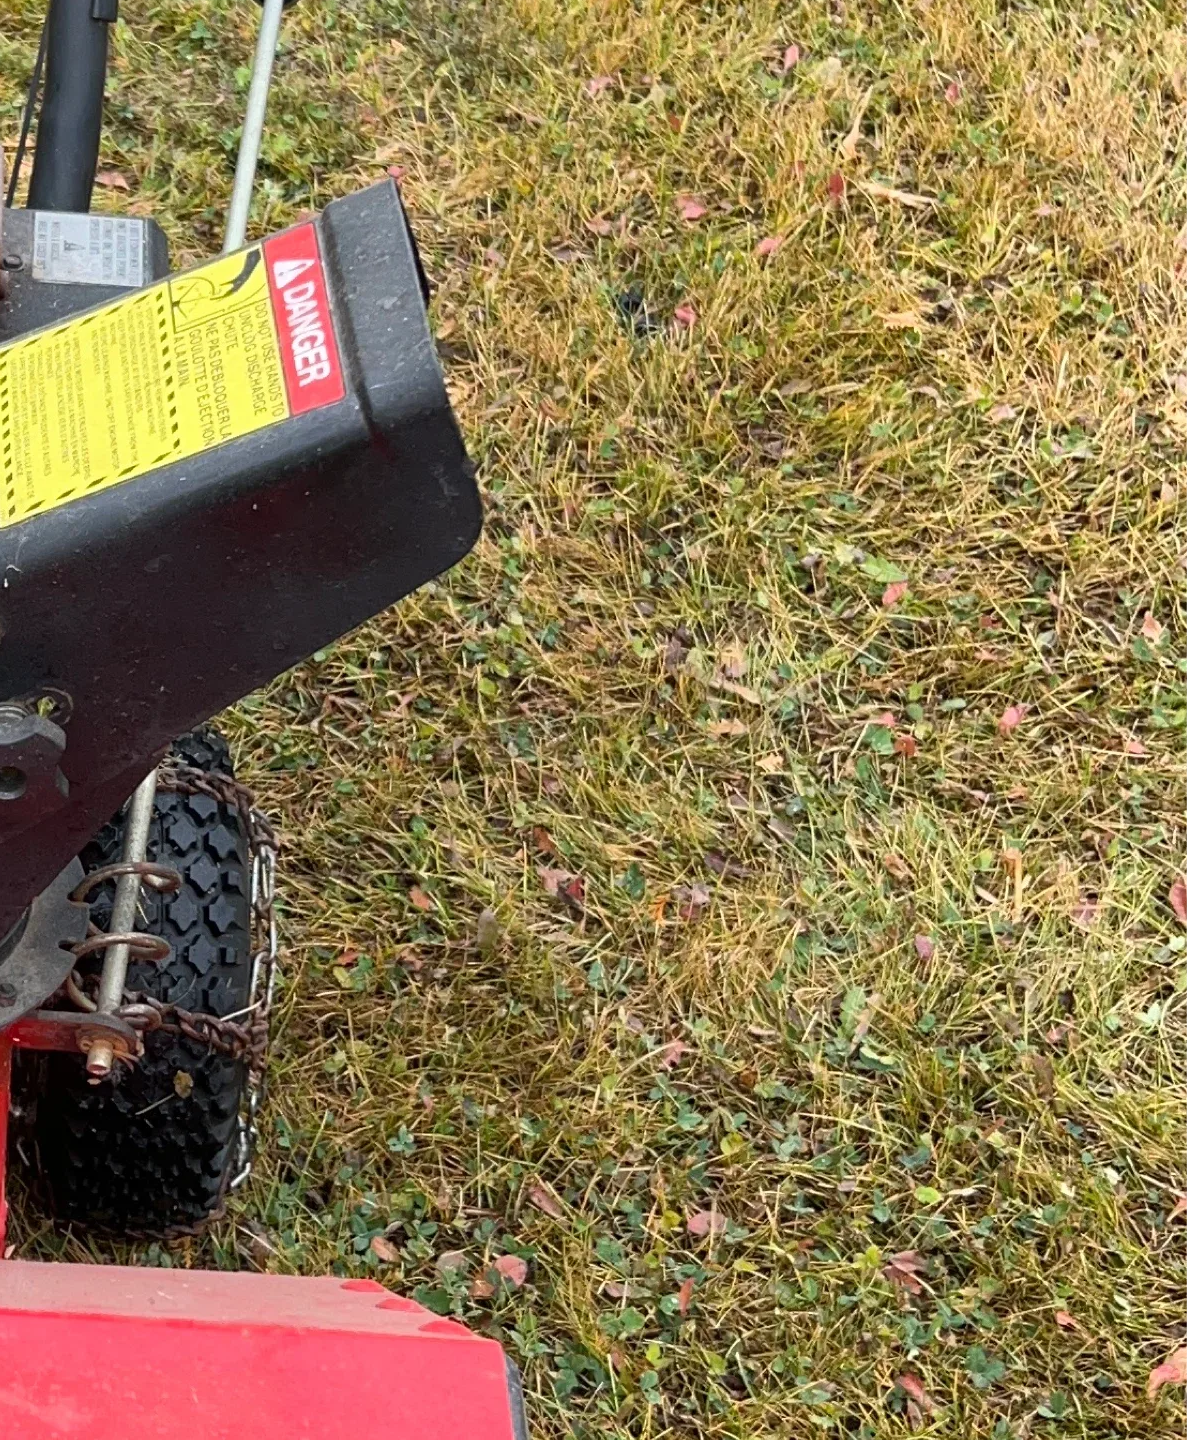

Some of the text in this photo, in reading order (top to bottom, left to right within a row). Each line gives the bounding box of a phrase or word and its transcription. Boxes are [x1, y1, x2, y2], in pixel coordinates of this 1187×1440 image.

[189, 329, 206, 382] GOULOTTE
[205, 322, 218, 337] NE
[208, 337, 221, 358] PAS
[284, 281, 331, 388] DANGER
[239, 309, 266, 414] UNCLOG DISCHARGE
[254, 302, 284, 416] DO NOT USE HANDS TO
[219, 424, 231, 439] LA
